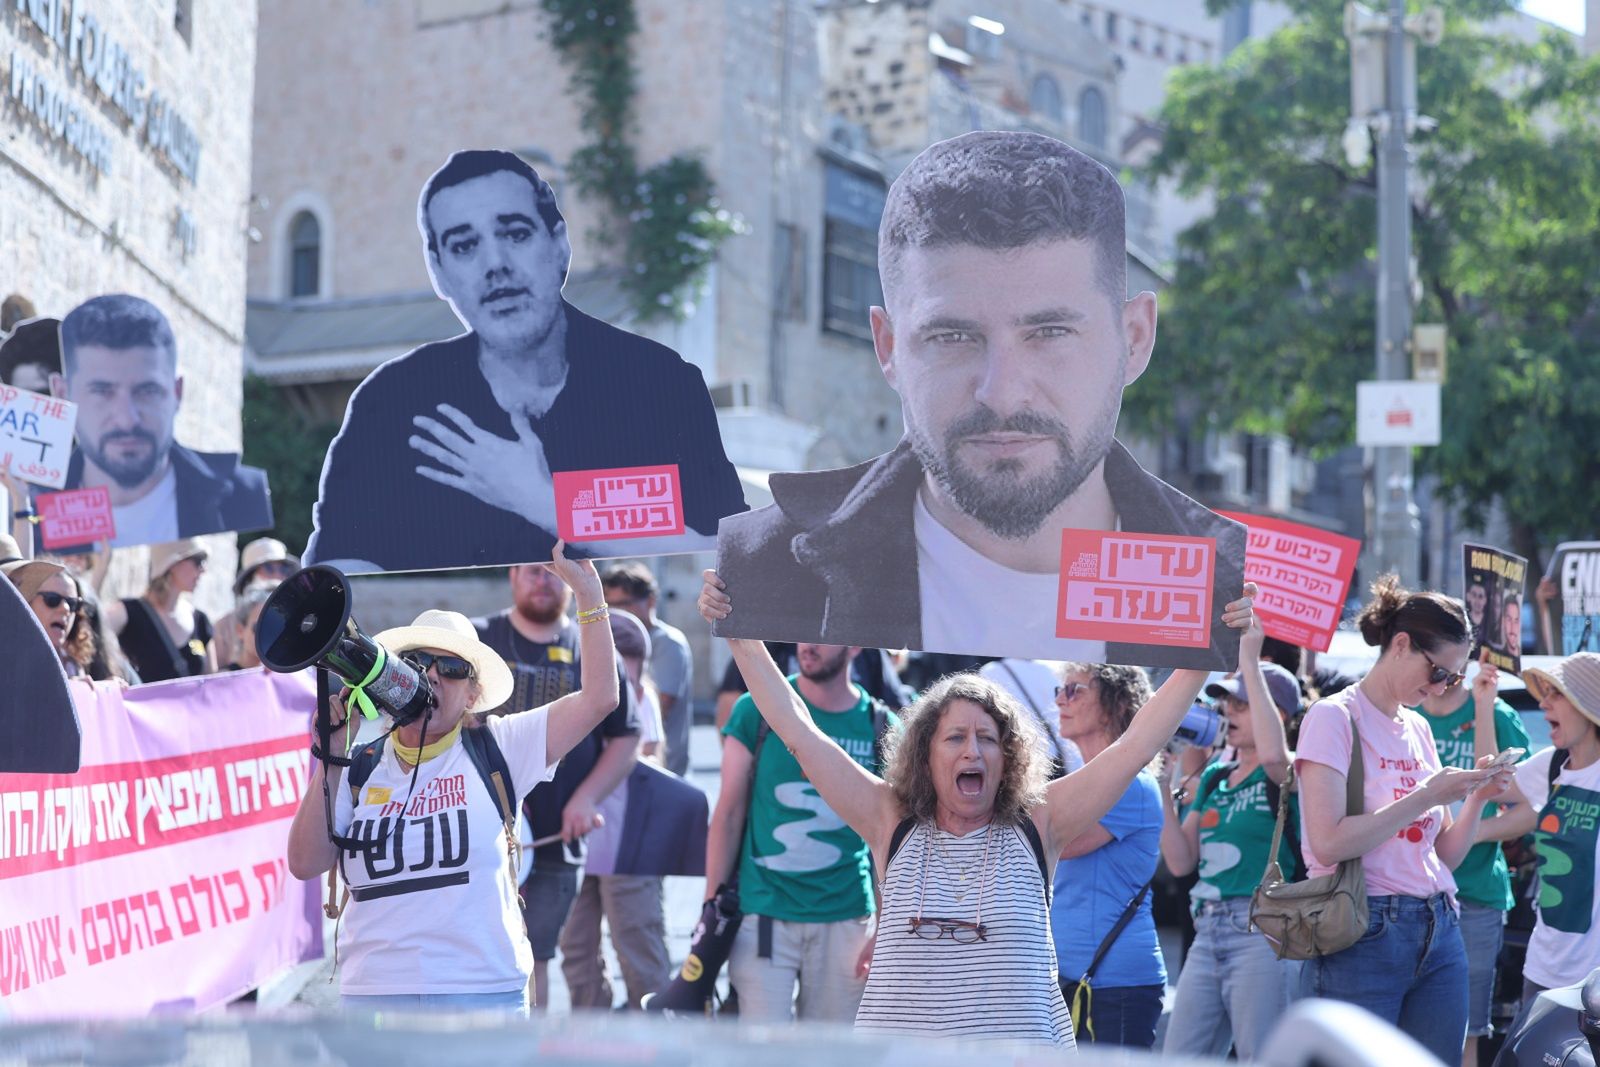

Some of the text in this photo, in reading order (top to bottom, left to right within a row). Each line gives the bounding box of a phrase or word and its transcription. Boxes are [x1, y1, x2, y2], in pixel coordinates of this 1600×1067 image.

[31, 394, 68, 420] THE
[0, 408, 39, 436] AR
[598, 476, 668, 505] עדיין
[584, 506, 673, 532] בעזה.
[1107, 542, 1204, 578] עדיין
[1275, 539, 1331, 564] כיבוש
[1275, 568, 1332, 594] הקרבת
[1079, 587, 1202, 624] בעזה.
[1261, 592, 1322, 619] והקרבת
[90, 780, 131, 843] את
[134, 766, 223, 845] מפצץ
[428, 791, 467, 813] אותם
[1555, 796, 1600, 818] משנים
[0, 790, 39, 860] הח
[1562, 815, 1595, 836] כיוון
[169, 869, 250, 937] כולם
[81, 890, 174, 966] בהסכם
[26, 915, 67, 985] צאו
